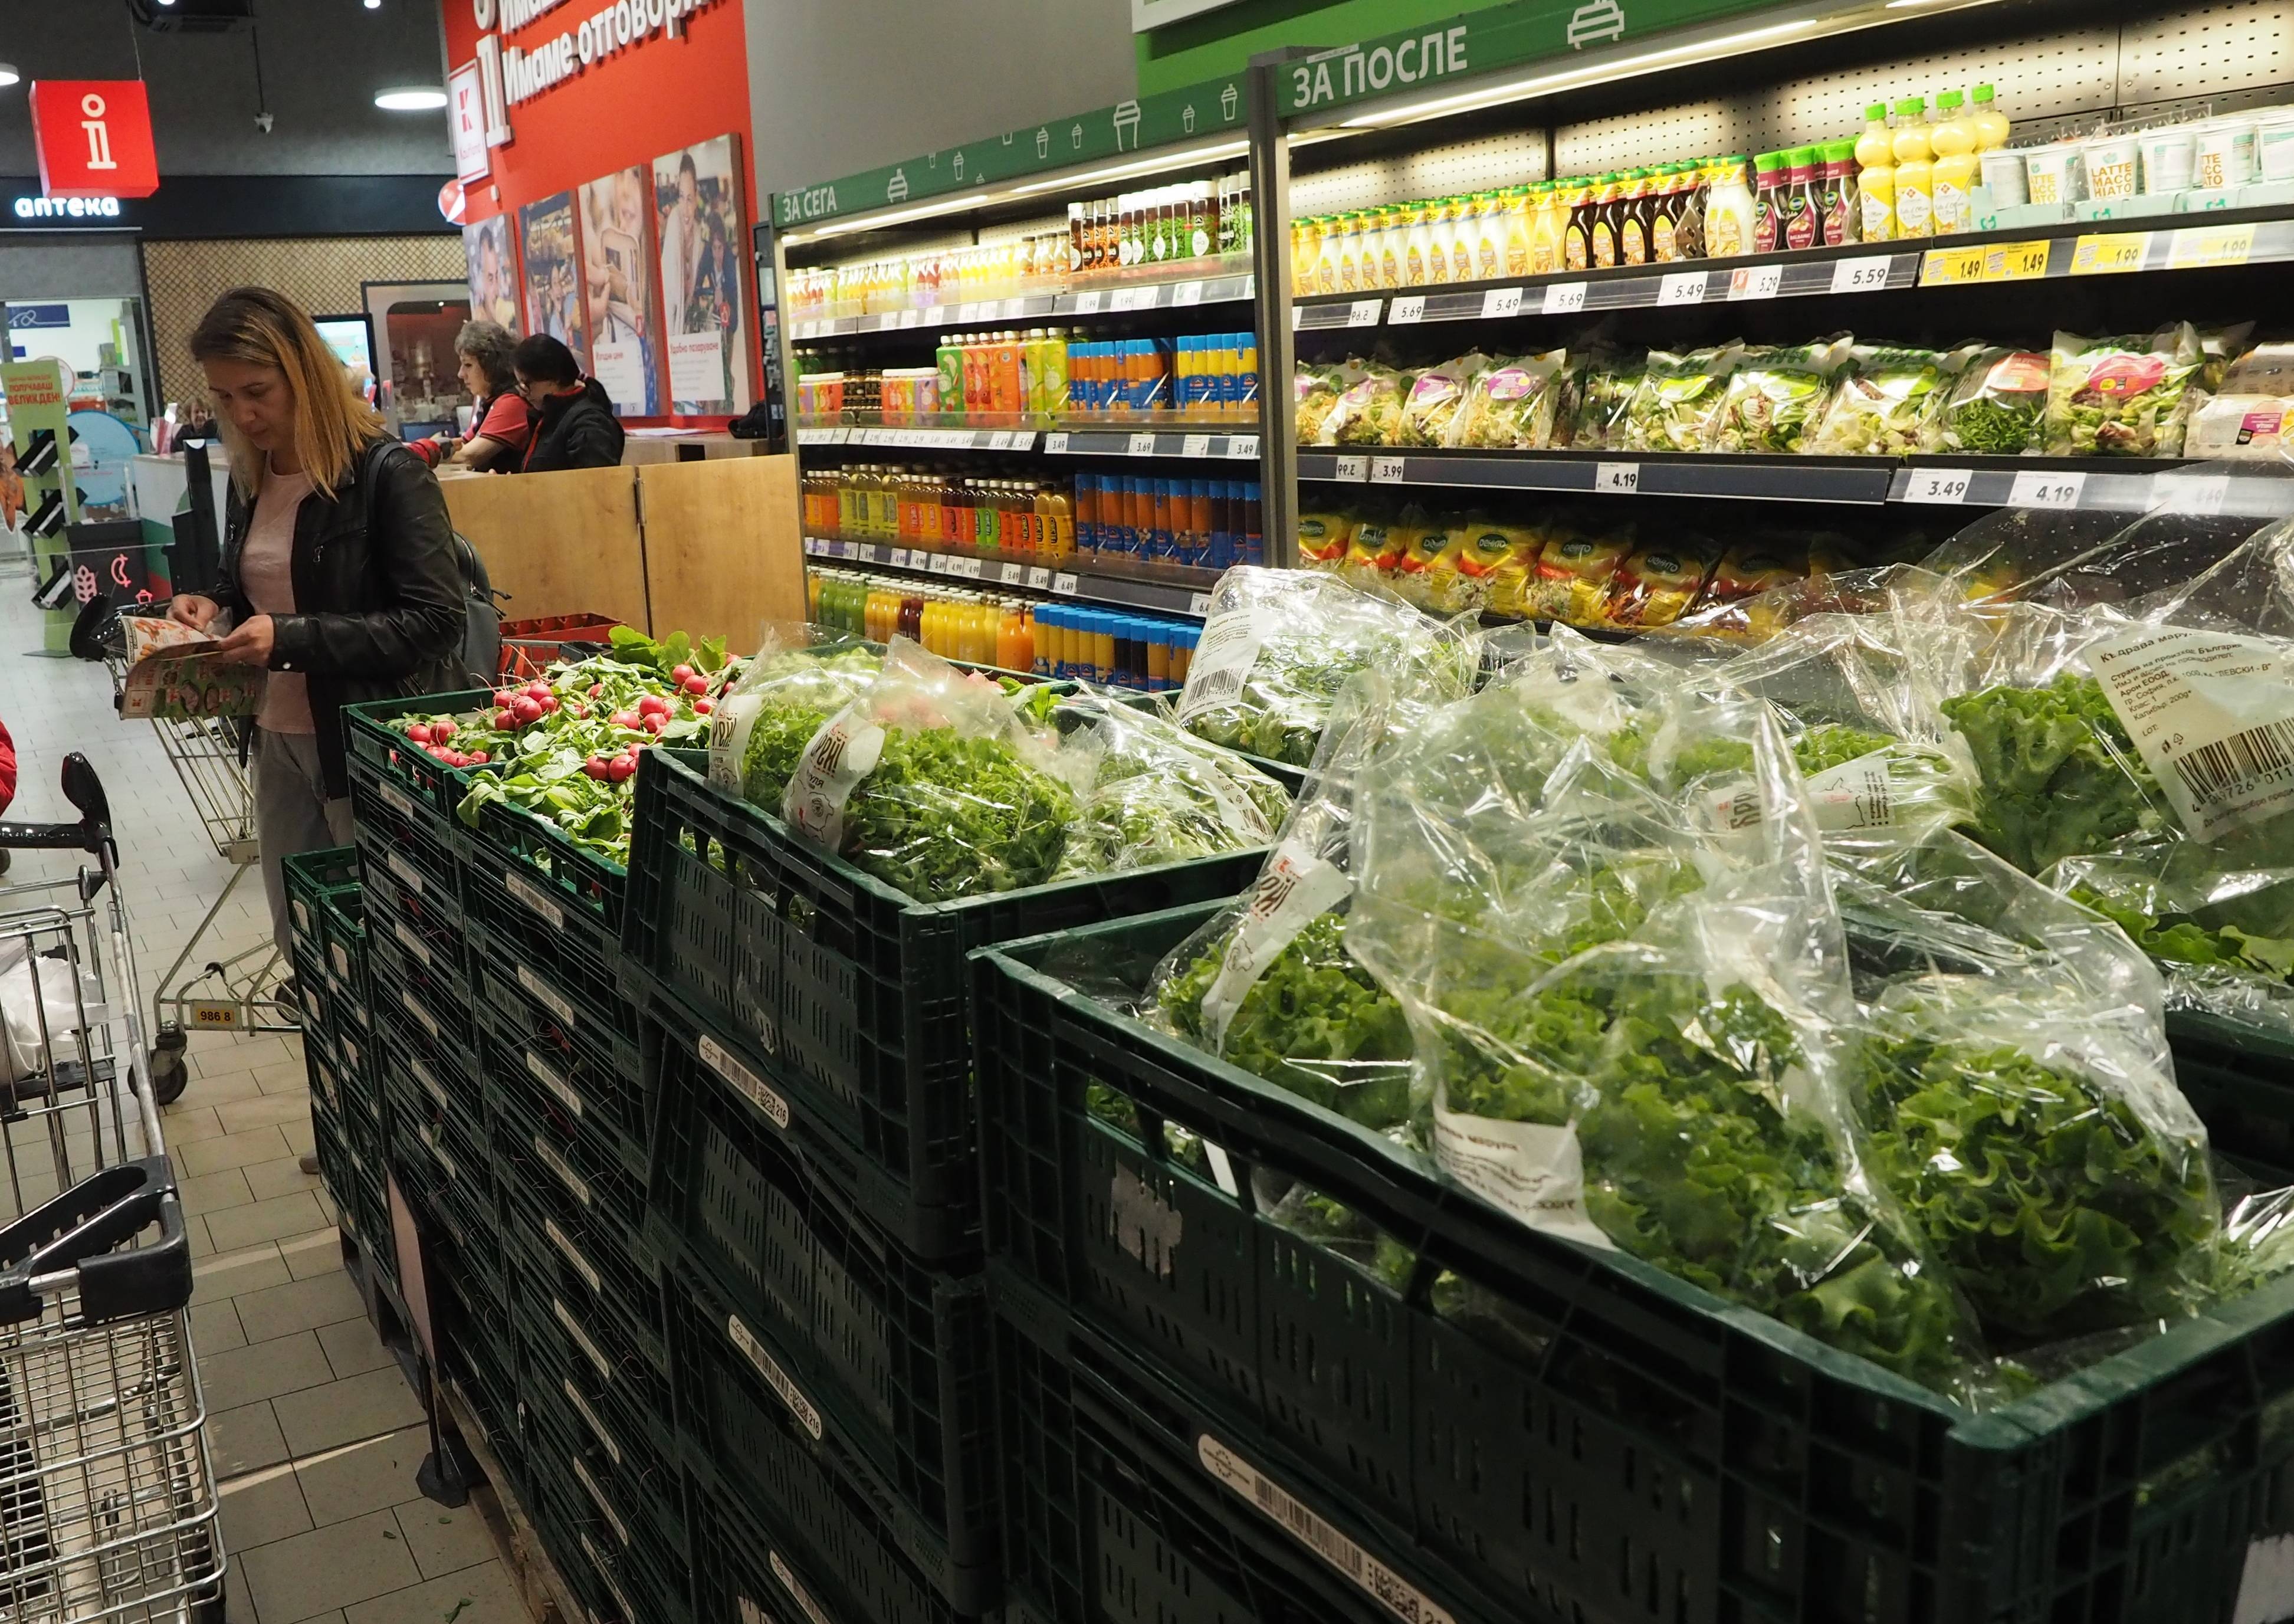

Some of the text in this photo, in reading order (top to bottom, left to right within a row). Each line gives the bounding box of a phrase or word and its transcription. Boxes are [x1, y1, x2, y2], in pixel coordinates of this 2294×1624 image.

[502, 0, 703, 105] Имаме отговор
[1293, 25, 1468, 108] ЗА ПОСЛЕ
[2091, 162, 2132, 177] LATTE
[2093, 172, 2132, 188] MACC
[2095, 182, 2132, 198] HIATO
[14, 195, 120, 217] аптека
[783, 185, 838, 222] ЗА СЕГА
[2221, 239, 2247, 260] 1.99
[2022, 253, 2044, 273] 1.49
[2115, 248, 2139, 267] 1.99
[1852, 268, 1886, 285] 5.59
[1960, 260, 1981, 279] 1.49
[1675, 284, 1704, 298] 5.49
[1759, 277, 1778, 293] 5.29
[1496, 298, 1520, 311] 5.49
[1558, 293, 1583, 307] 5.69
[1401, 306, 1422, 319] 5.69
[1052, 440, 1065, 450] 3.49
[1137, 443, 1151, 452] 3.69
[1237, 444, 1253, 455] 3.49
[1383, 465, 1403, 478] 3.99
[1612, 473, 1637, 488] 4.19
[1927, 481, 1966, 496] 3.49
[2036, 485, 2075, 502] 4.19
[915, 556, 925, 566] 4.99
[951, 562, 962, 572] 4.99
[968, 564, 979, 574] 4.99
[1007, 570, 1020, 580] 5.49
[1035, 575, 1047, 585] 5.49
[1062, 580, 1074, 590] 6.49
[1199, 602, 1210, 612] 6.4
[2100, 632, 2199, 663] Къдрава мару
[2111, 665, 2141, 682] Страна
[2120, 684, 2142, 698] Арон
[2142, 723, 2159, 737] LOT:
[2191, 802, 2201, 813] 4
[2264, 766, 2294, 786] 011
[201, 1011, 231, 1021] 986 8
[776, 1104, 786, 1122] 216
[808, 1412, 821, 1434] 216
